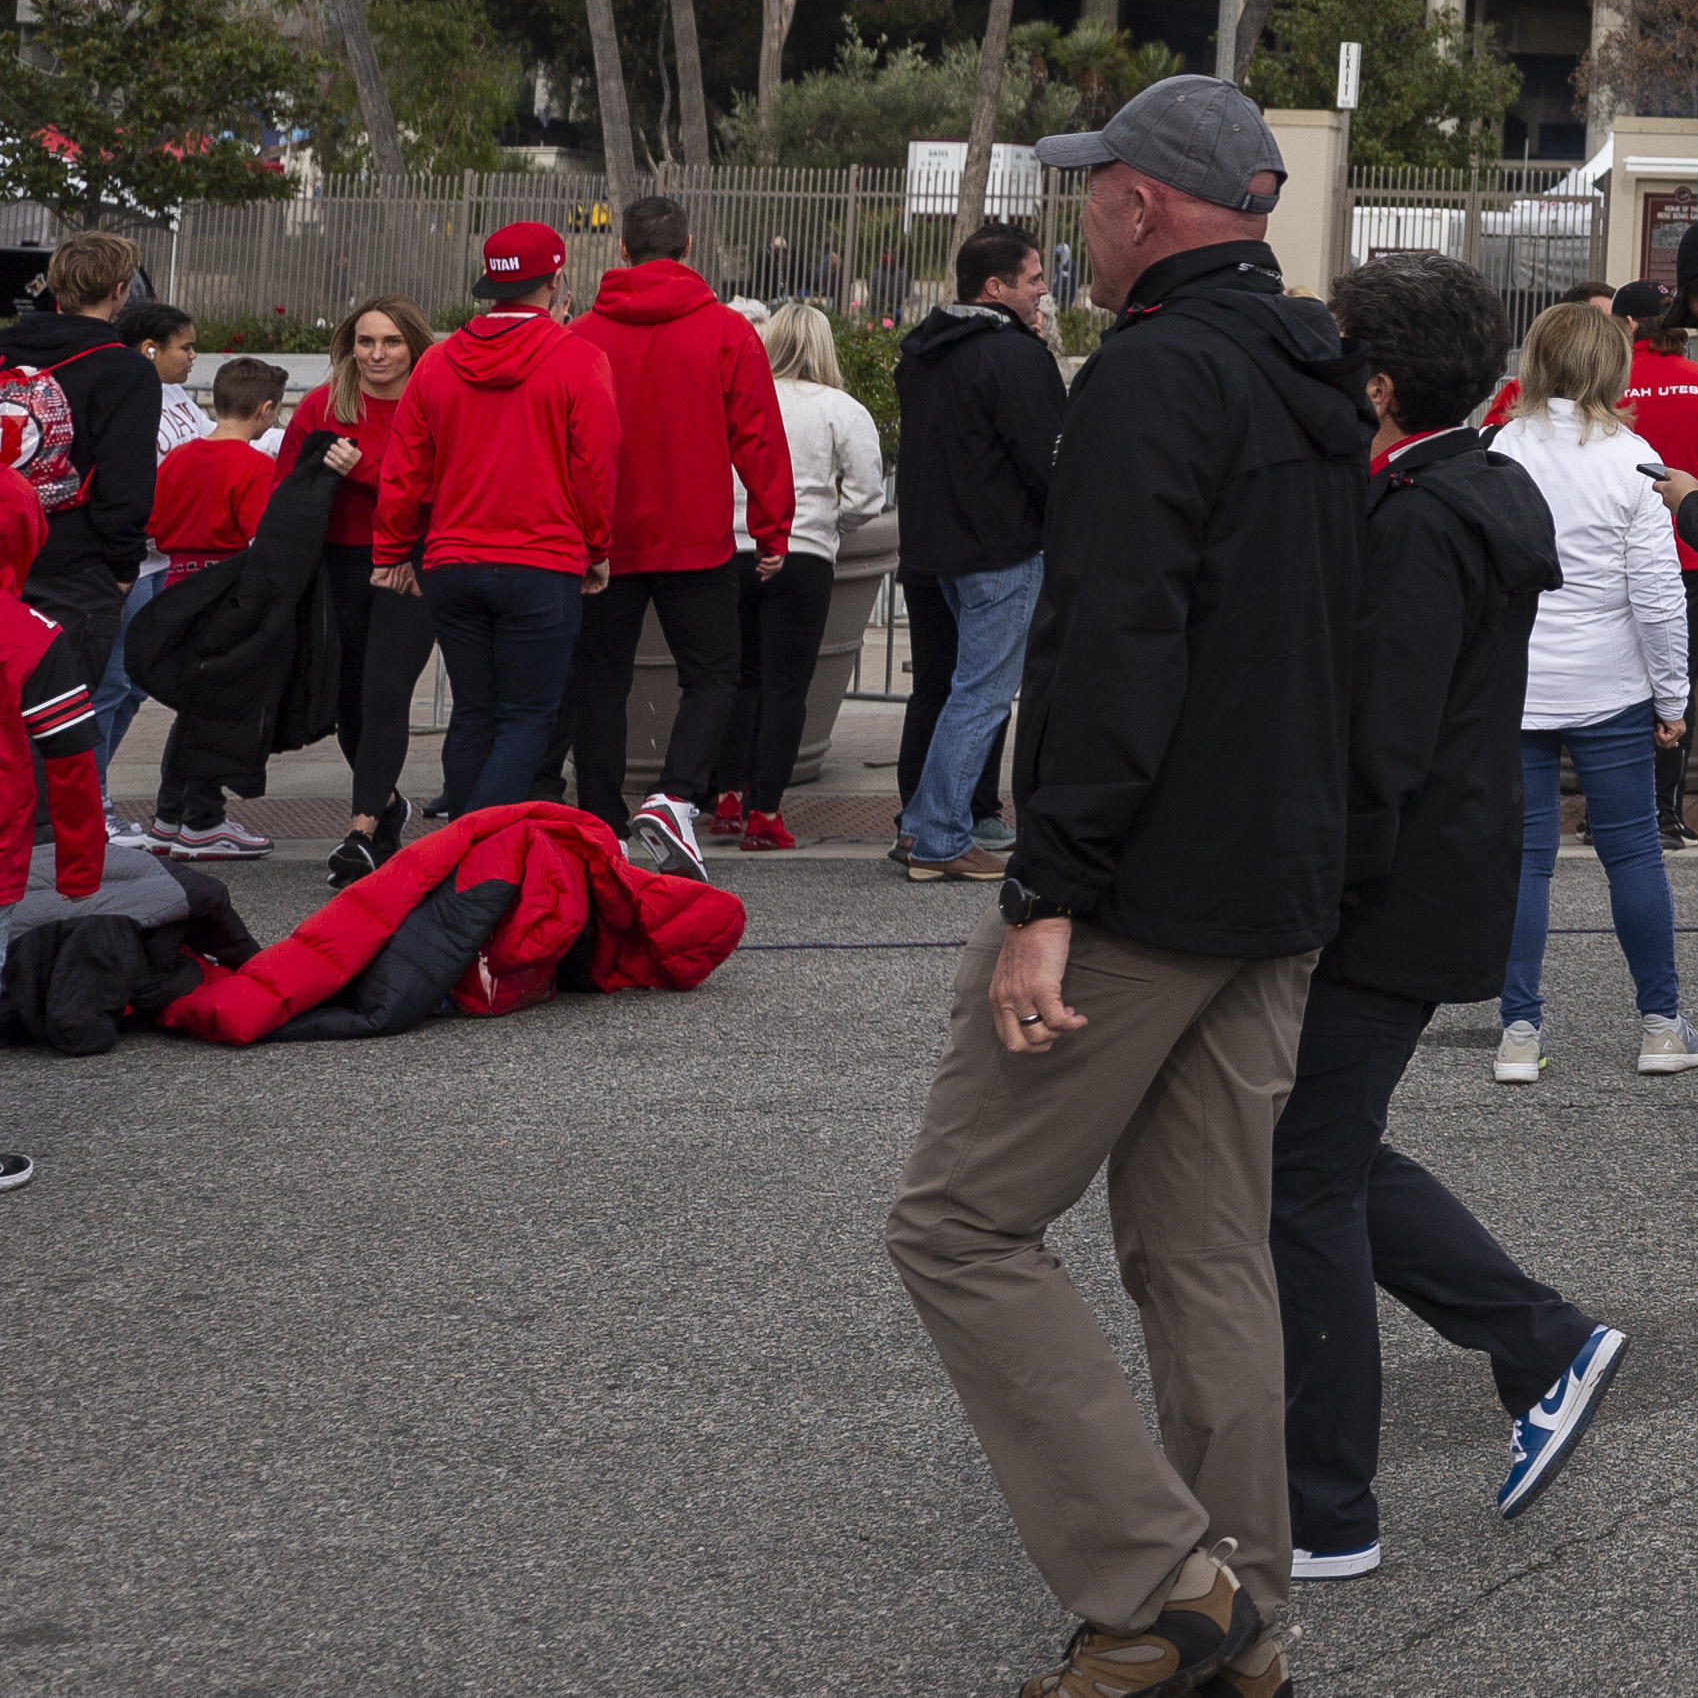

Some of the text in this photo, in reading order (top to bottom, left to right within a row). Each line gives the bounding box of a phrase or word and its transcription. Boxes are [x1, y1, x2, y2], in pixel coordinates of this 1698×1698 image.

[489, 256, 520, 271] UTAH
[1624, 385, 1698, 398] TAH UTES
